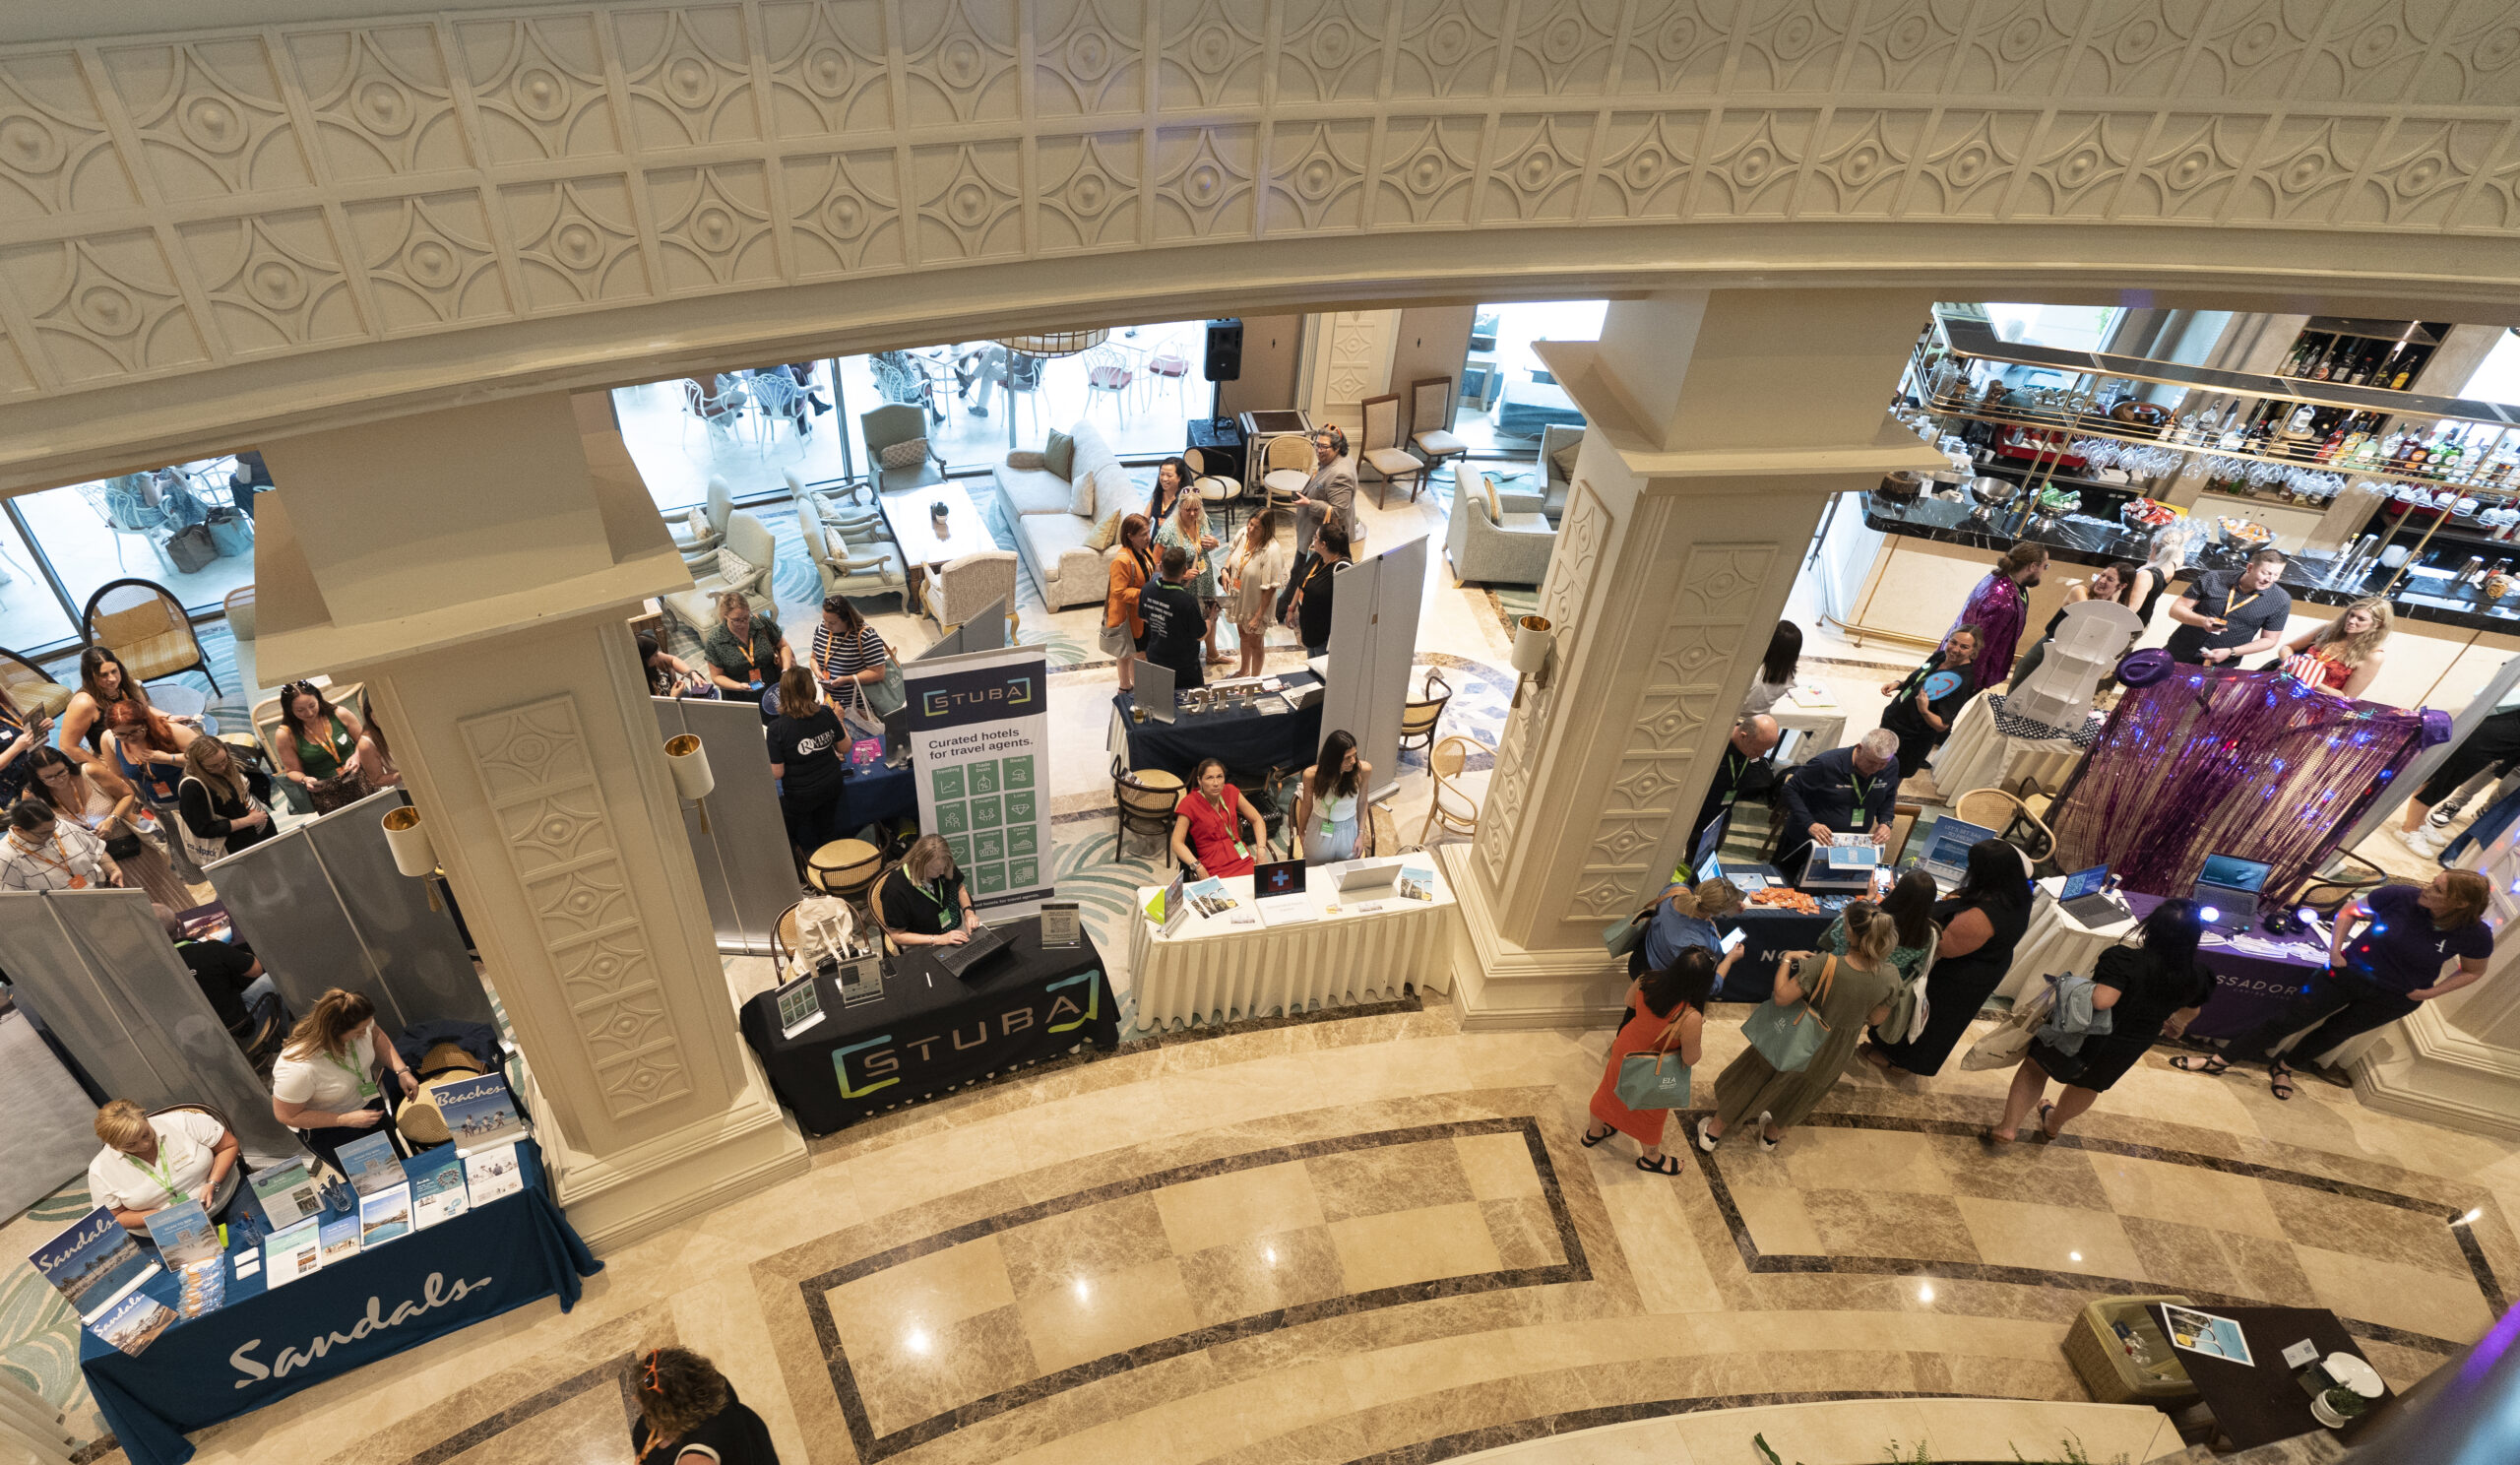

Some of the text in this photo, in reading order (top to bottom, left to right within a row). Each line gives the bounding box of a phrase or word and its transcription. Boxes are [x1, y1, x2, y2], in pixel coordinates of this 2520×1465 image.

[935, 686, 1022, 709] STUBA
[801, 729, 835, 753] RIVIERA
[928, 728, 1020, 749] Curated hotels
[929, 737, 1034, 760] for travel agents.
[2216, 975, 2298, 995] SSADOR
[864, 996, 1081, 1078] STUBA
[434, 1085, 506, 1107] Beaches
[39, 1219, 117, 1274] Sandals
[94, 1294, 146, 1336] Sandals
[229, 1272, 492, 1389] Sandals
